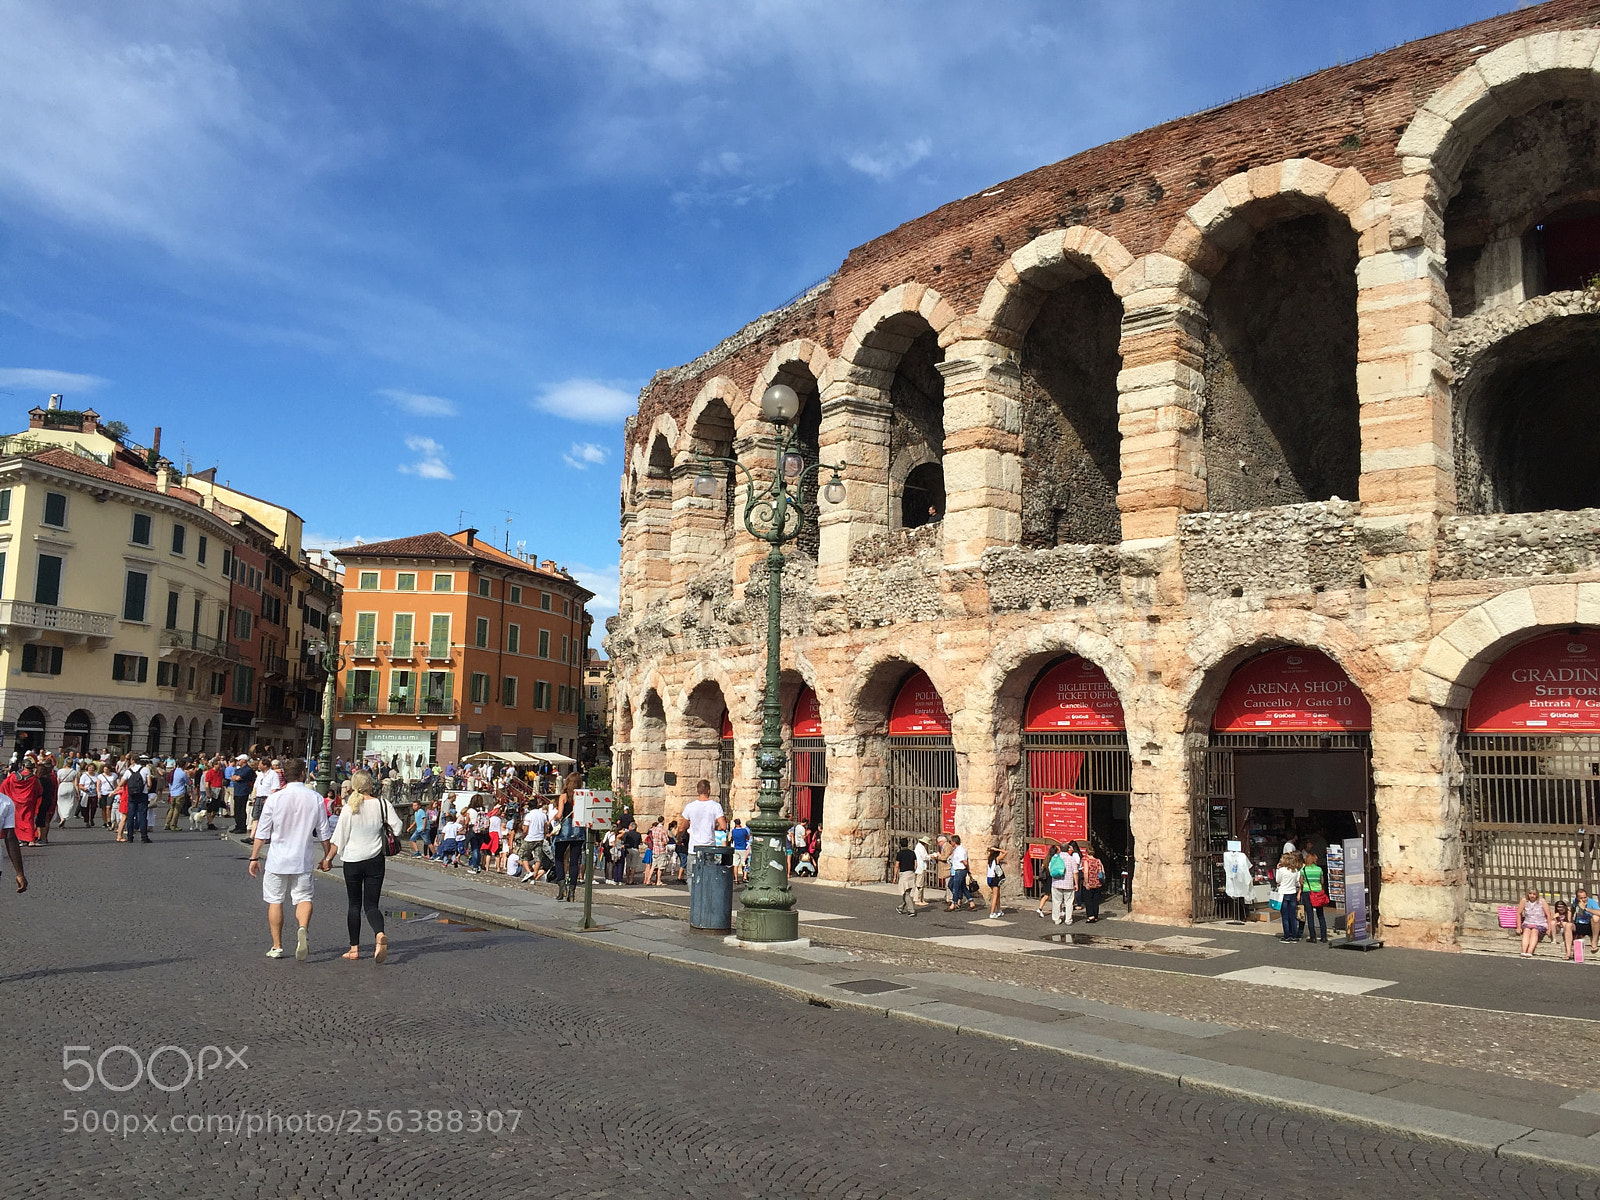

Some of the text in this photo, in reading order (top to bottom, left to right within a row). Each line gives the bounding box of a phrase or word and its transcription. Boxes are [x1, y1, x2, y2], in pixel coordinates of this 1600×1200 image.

[1512, 668, 1599, 683] GRADIN
[1246, 680, 1348, 695] ARENA SHOP
[1057, 692, 1088, 701] TICKET
[1243, 696, 1351, 709] Cancello / Gate 10
[1529, 699, 1571, 708] Entrata
[1575, 699, 1581, 708] /
